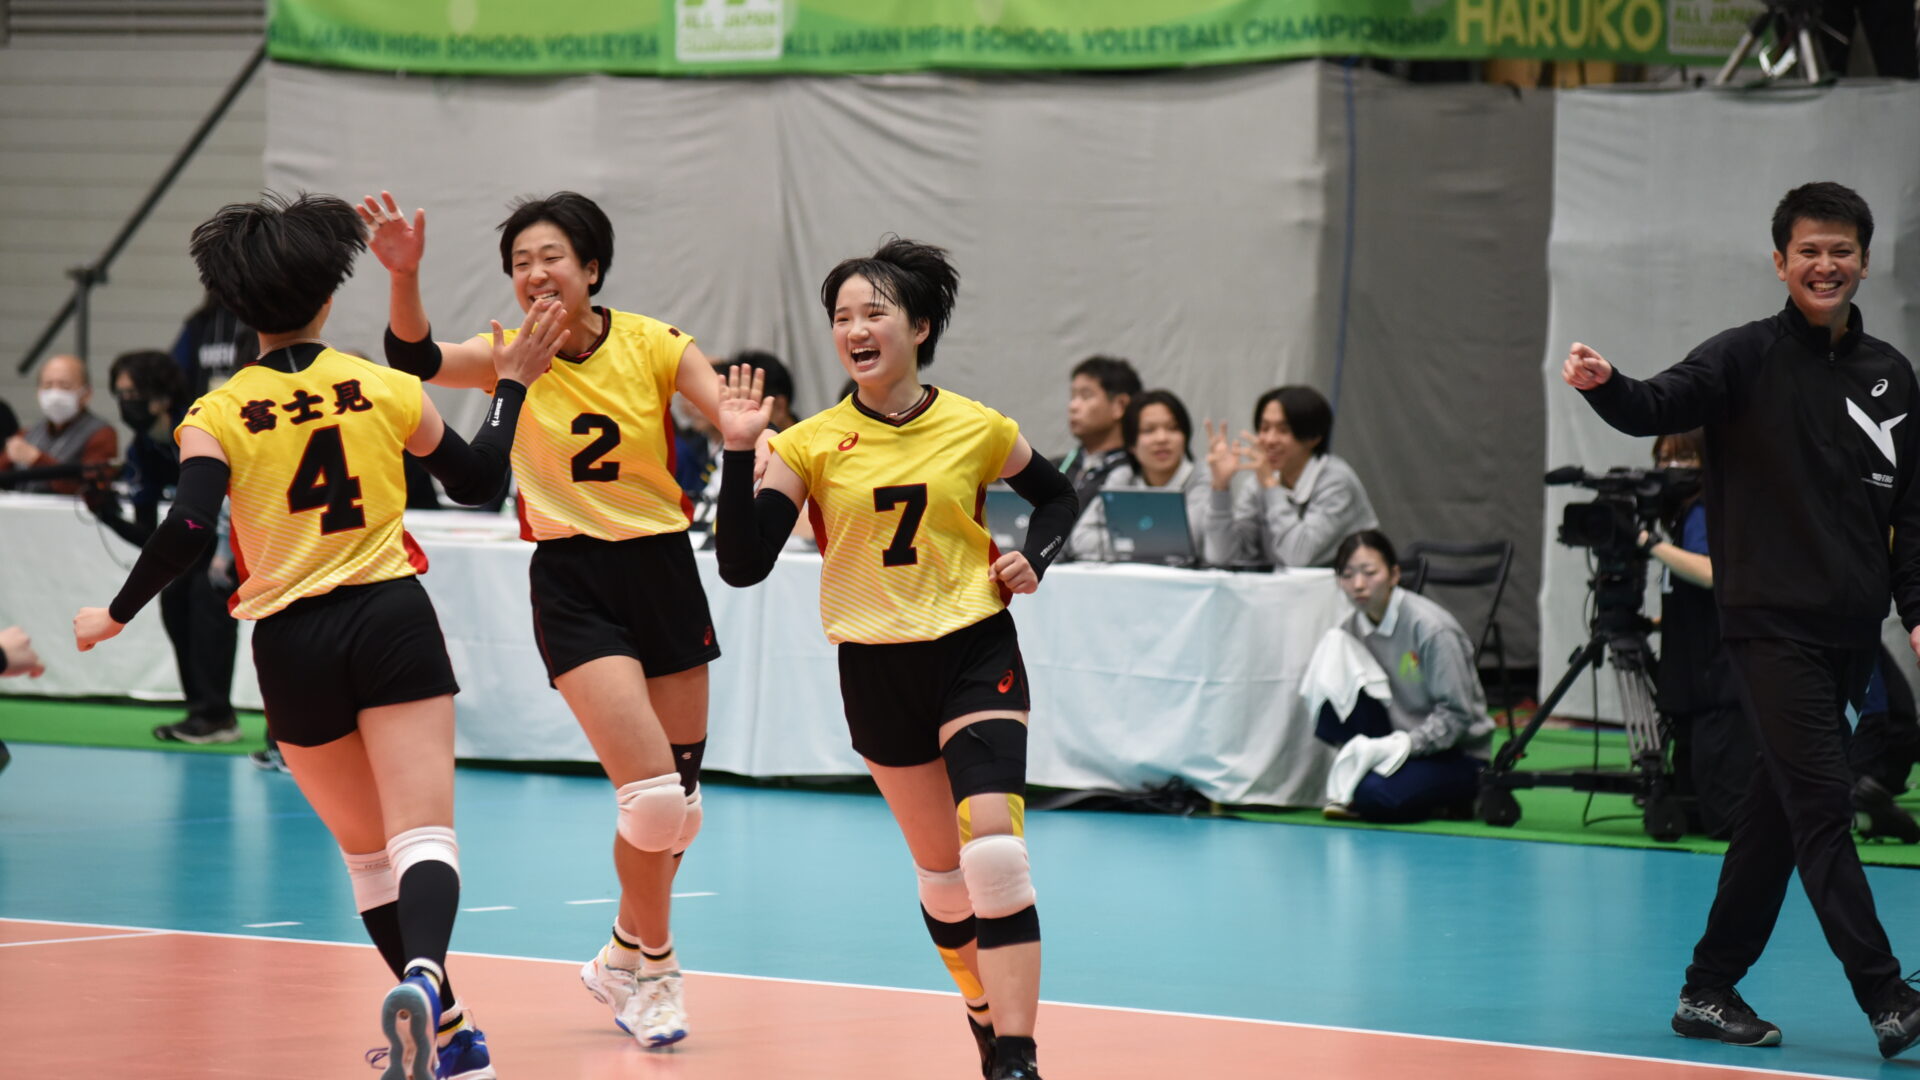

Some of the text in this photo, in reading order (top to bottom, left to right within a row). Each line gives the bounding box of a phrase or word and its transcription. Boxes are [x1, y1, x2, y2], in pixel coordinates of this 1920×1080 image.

[383, 32, 438, 55] HIGH
[446, 34, 538, 60] SCHOOL
[783, 33, 820, 56] ALL
[827, 29, 901, 57] JAPAN
[907, 26, 964, 52] HIGH
[974, 25, 1072, 55] SCHOOL
[1081, 22, 1235, 53] VOLLEYBALL
[1456, 0, 1663, 52] HARUKO
[240, 379, 373, 435] 富士見
[571, 412, 621, 483] 2
[286, 423, 367, 536] 4
[873, 483, 928, 567] 7
